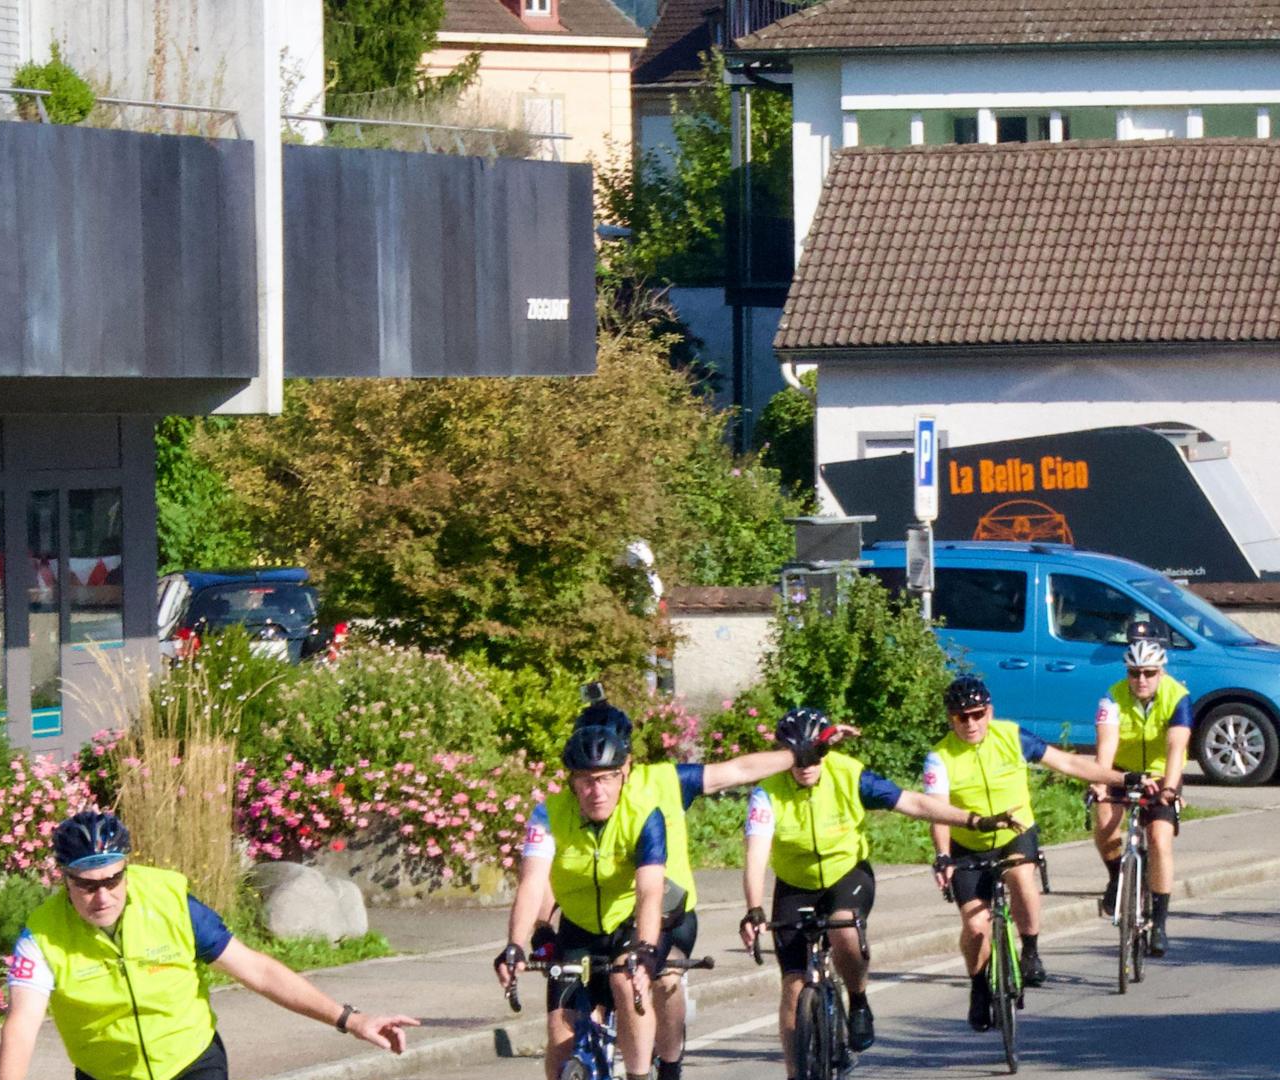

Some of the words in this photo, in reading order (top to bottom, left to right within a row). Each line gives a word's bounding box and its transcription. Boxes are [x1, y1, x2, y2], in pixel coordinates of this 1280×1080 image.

[920, 430, 932, 480] P
[949, 460, 975, 494] La
[979, 458, 1035, 493] Bella
[1040, 455, 1089, 490] Ciao
